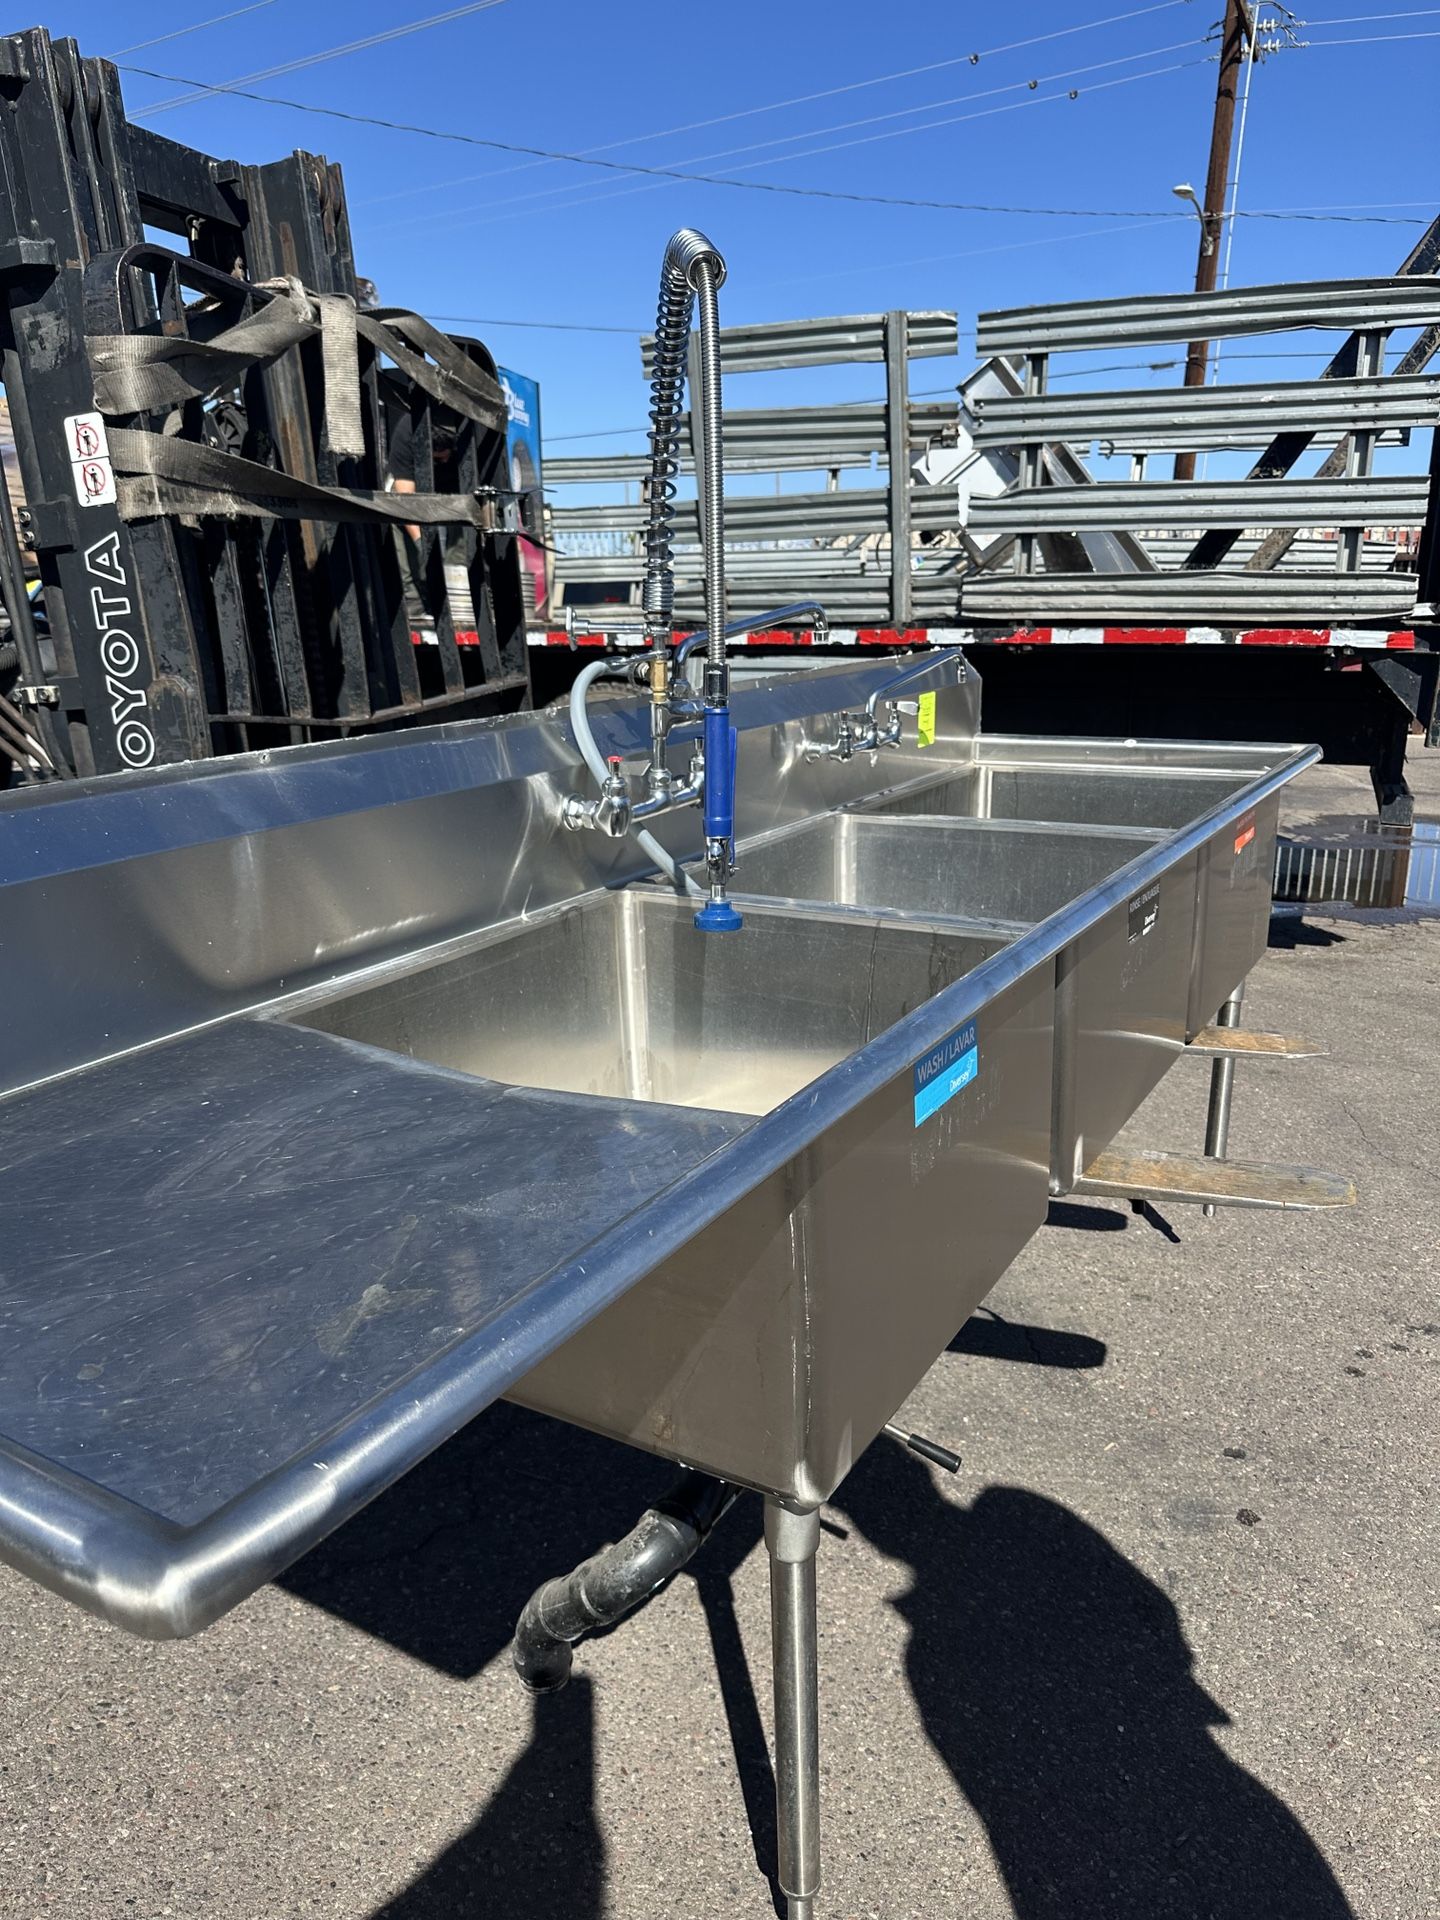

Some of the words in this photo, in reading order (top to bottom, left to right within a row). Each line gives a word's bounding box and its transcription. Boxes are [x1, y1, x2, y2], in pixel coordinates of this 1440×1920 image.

[84, 531, 155, 768] OYOTA
[917, 1053, 945, 1083] WASH
[949, 1027, 975, 1060] LAVAR
